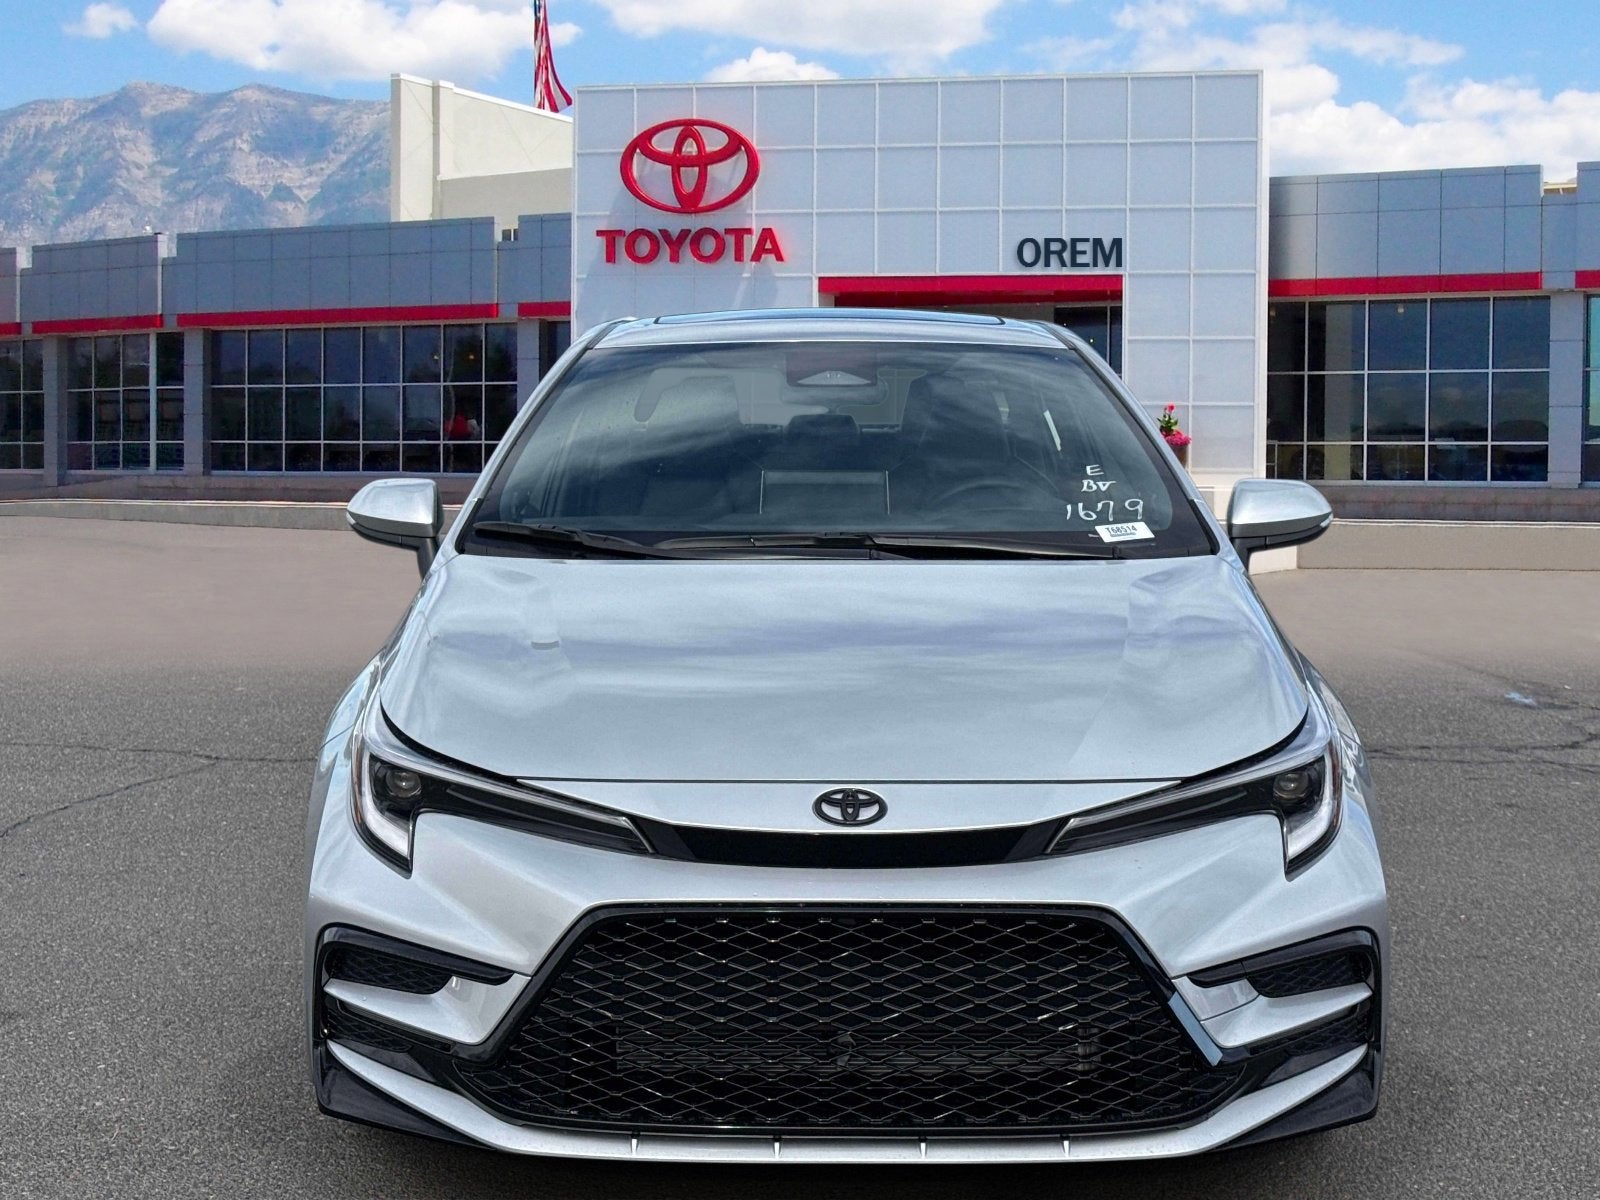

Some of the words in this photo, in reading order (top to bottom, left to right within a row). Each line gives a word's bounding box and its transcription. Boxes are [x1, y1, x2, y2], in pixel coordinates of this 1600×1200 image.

[596, 227, 785, 264] TOYOTA
[1016, 237, 1123, 268] OREM
[1086, 464, 1104, 476] E
[1066, 498, 1144, 521] 1679
